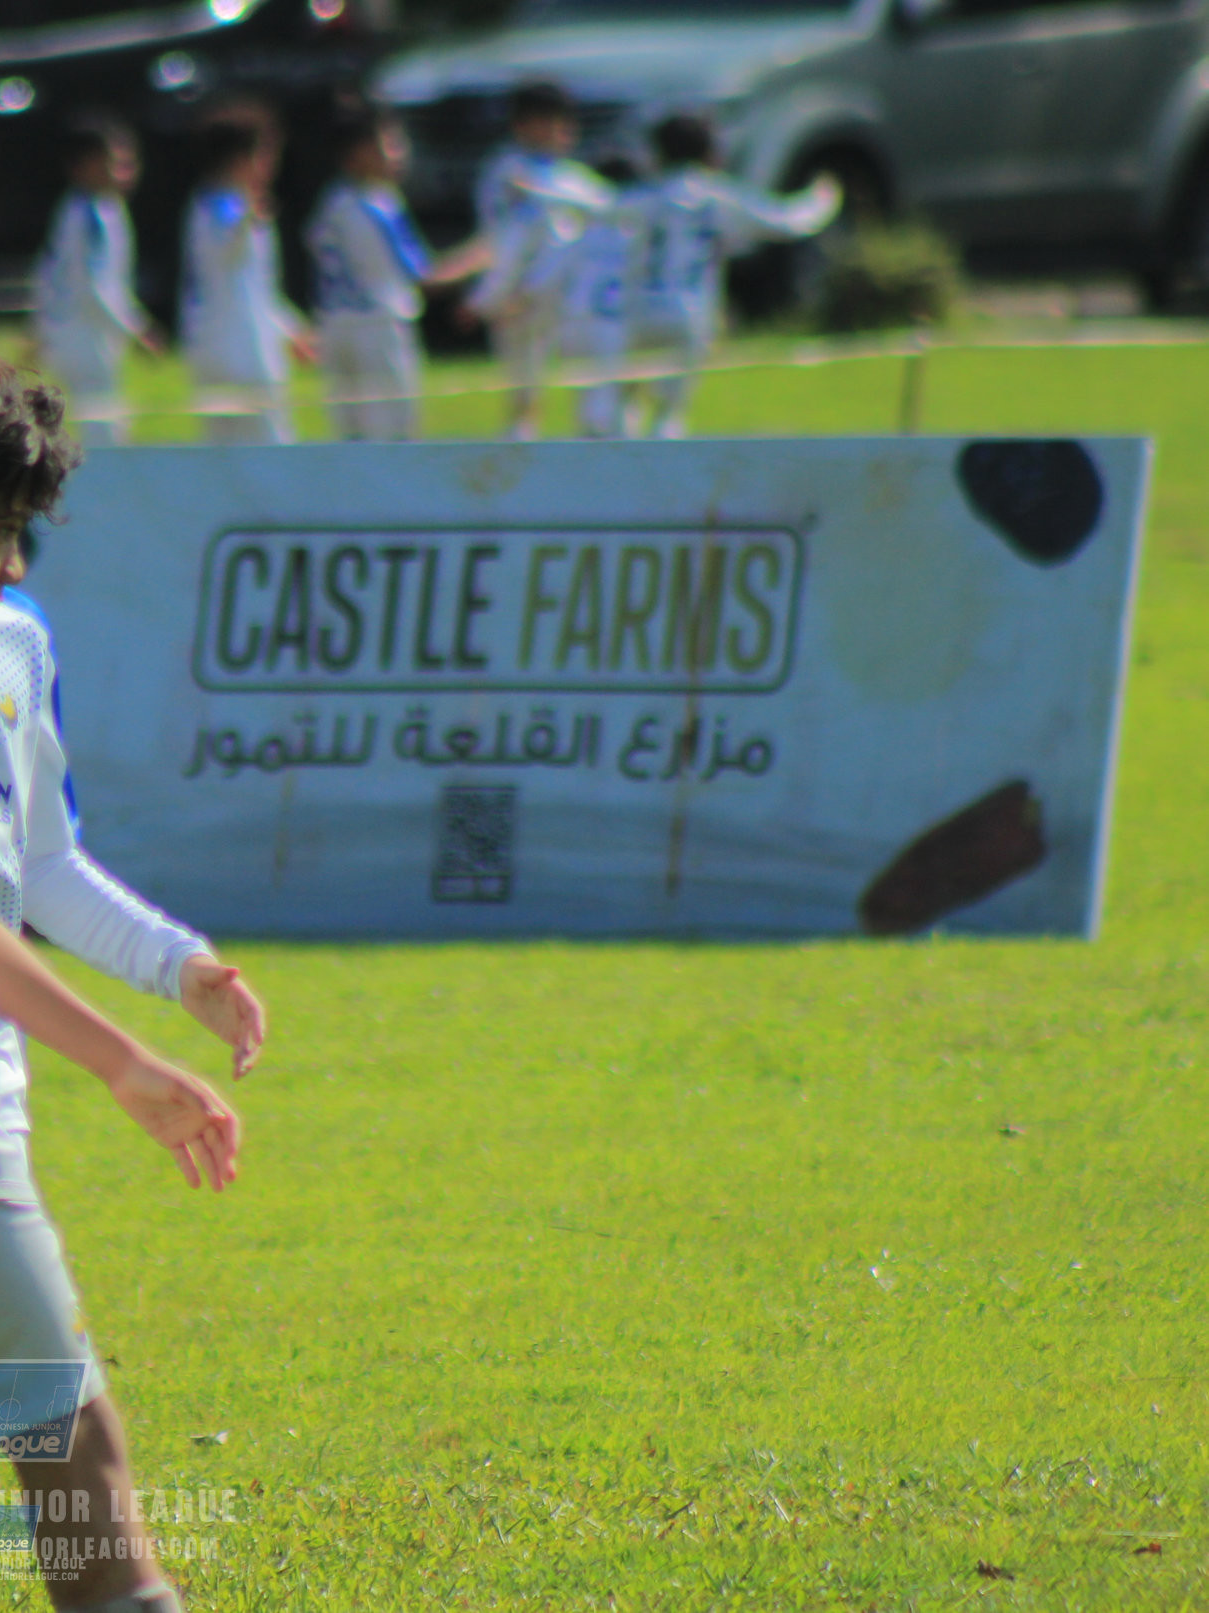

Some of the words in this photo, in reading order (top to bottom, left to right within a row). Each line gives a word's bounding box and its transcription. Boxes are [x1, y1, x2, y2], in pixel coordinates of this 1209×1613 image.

[216, 543, 501, 673] CASTLE
[516, 543, 782, 674] FARMS
[182, 714, 378, 779] للتمور
[393, 706, 601, 768] القلعة
[615, 711, 774, 781] مزارع
